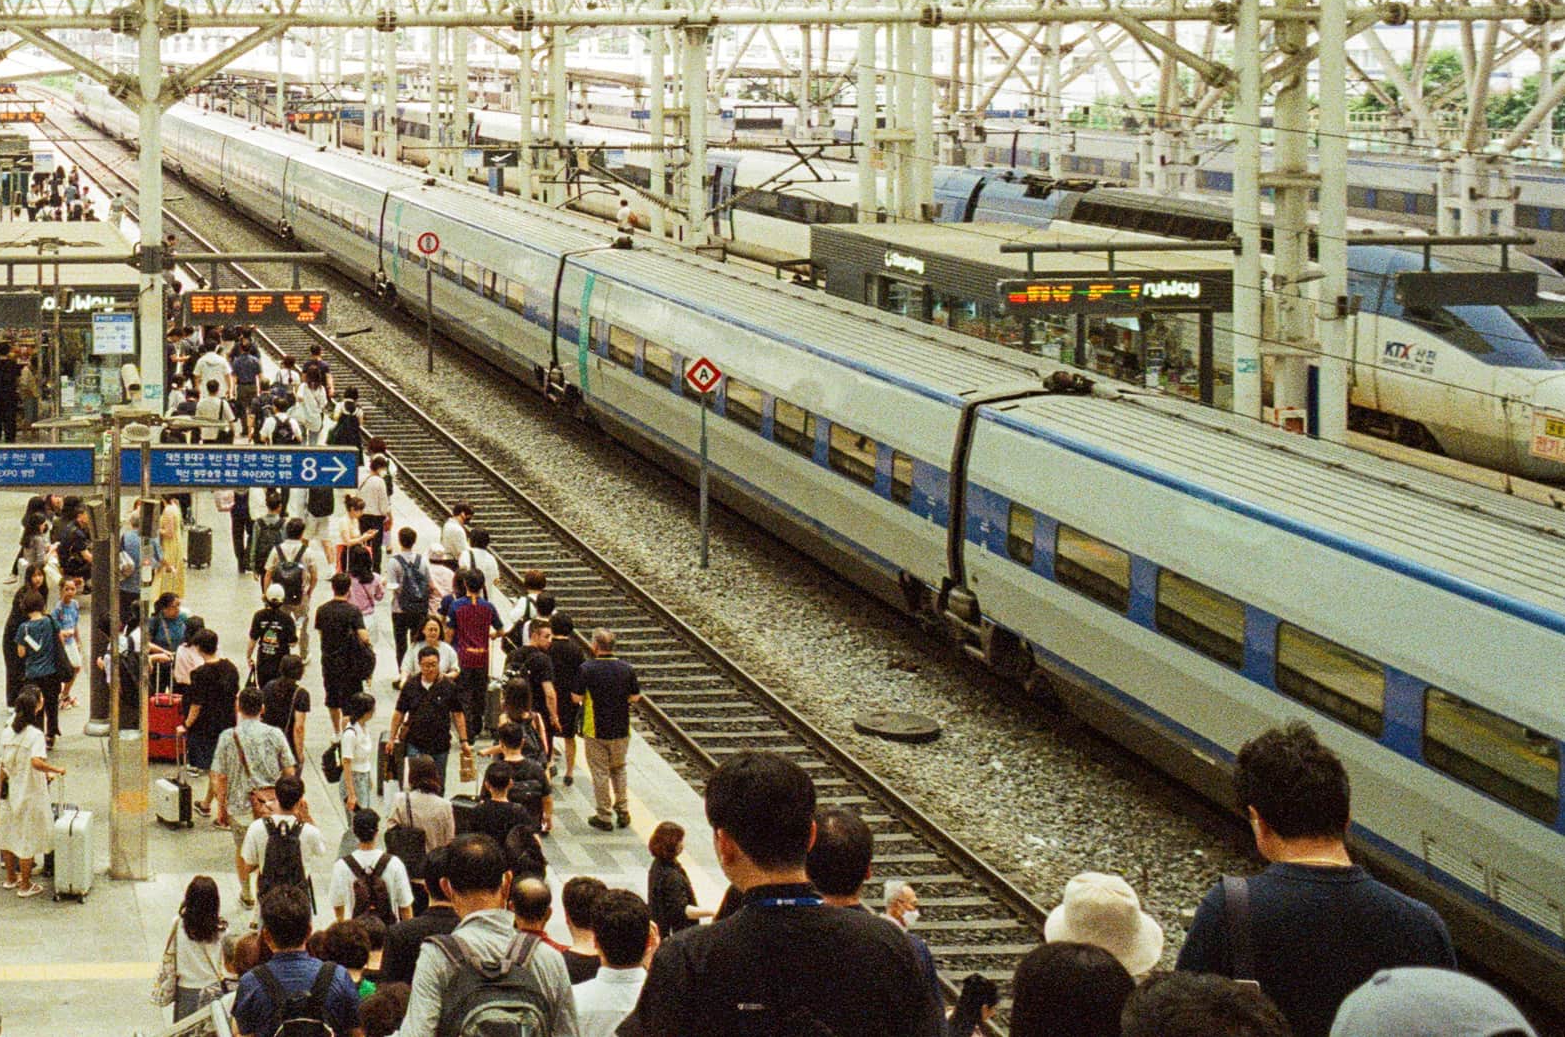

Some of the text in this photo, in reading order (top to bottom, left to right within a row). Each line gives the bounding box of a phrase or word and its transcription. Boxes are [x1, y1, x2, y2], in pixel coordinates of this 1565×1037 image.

[1143, 281, 1200, 298] ryWay
[1384, 341, 1417, 360] KTX
[699, 368, 709, 380] A
[301, 457, 317, 481] 8
